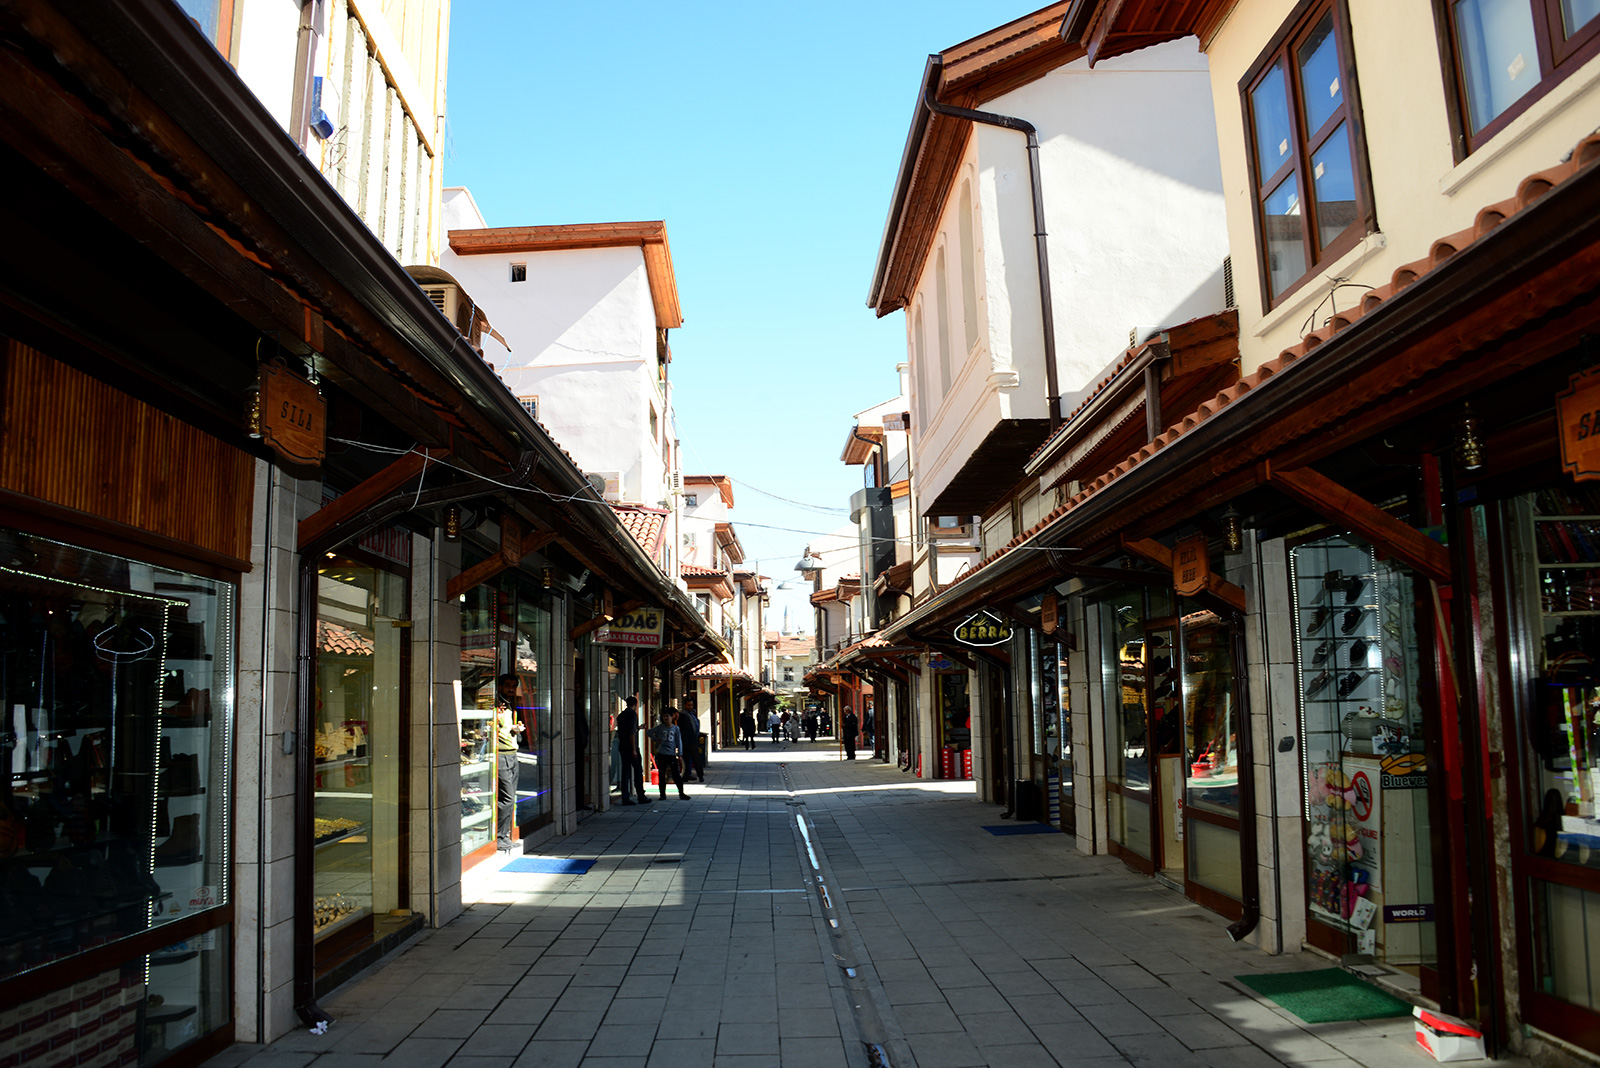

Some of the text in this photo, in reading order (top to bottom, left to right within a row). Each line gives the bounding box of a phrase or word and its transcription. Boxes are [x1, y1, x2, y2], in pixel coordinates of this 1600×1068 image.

[281, 401, 312, 431] SILA
[959, 626, 1010, 640] BERRA
[662, 730, 674, 742] 36
[1391, 909, 1426, 917] WORLD
